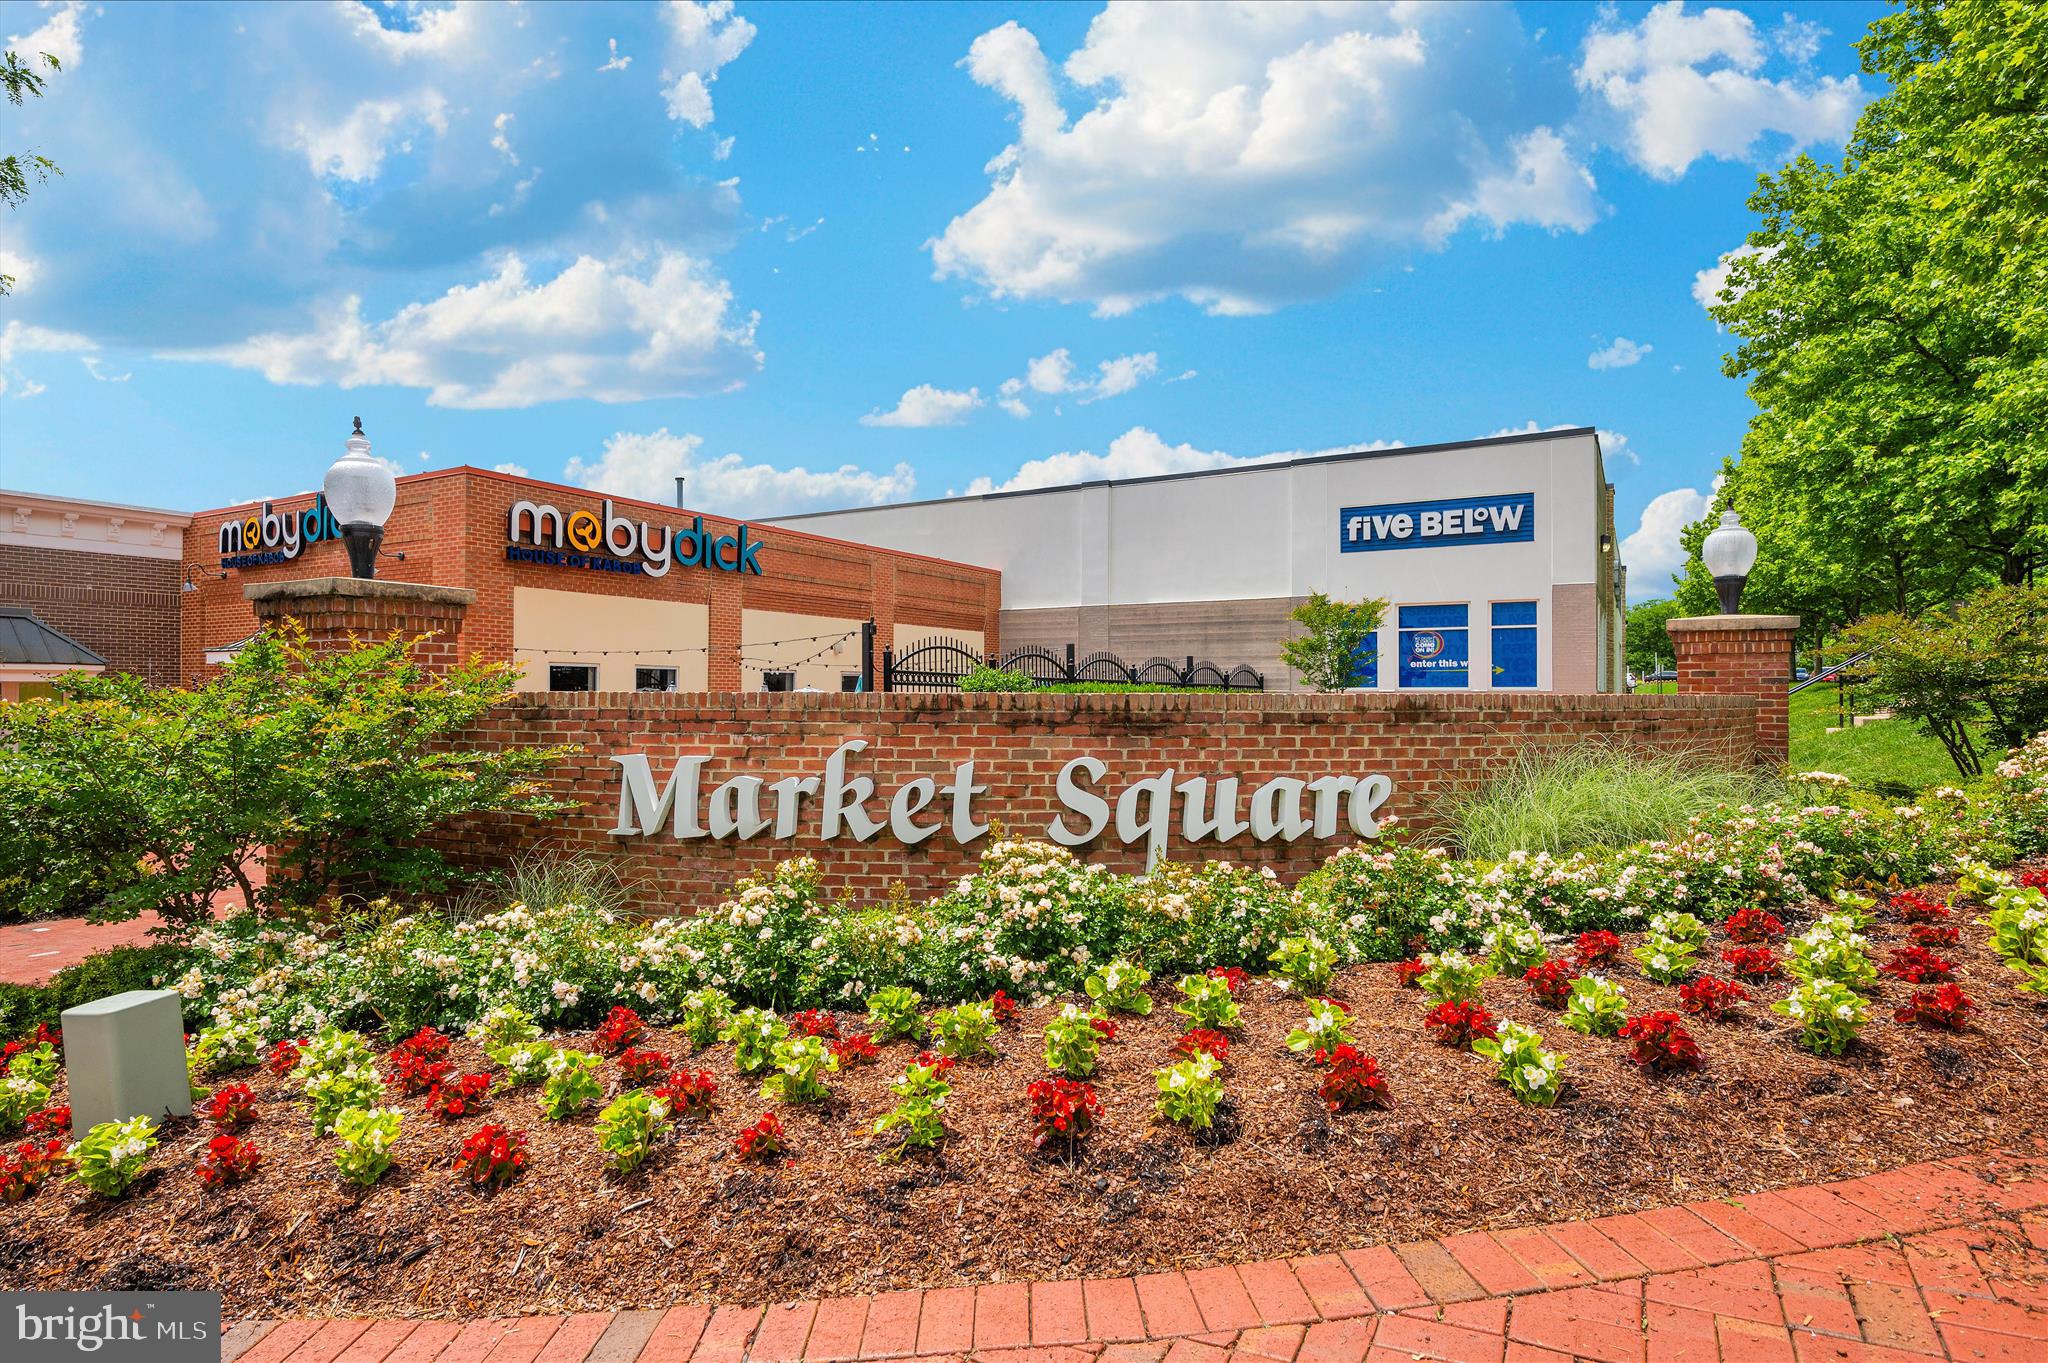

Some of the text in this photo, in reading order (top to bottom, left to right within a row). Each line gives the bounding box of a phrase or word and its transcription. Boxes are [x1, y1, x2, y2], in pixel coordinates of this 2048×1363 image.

[1420, 504, 1525, 537] BELOW
[221, 551, 285, 568] HOUSE OF KABOB
[508, 546, 641, 575] HOUSE OF KABOB
[1410, 660, 1437, 668] enter
[1439, 659, 1458, 668] this
[608, 739, 1392, 880] Market Square
